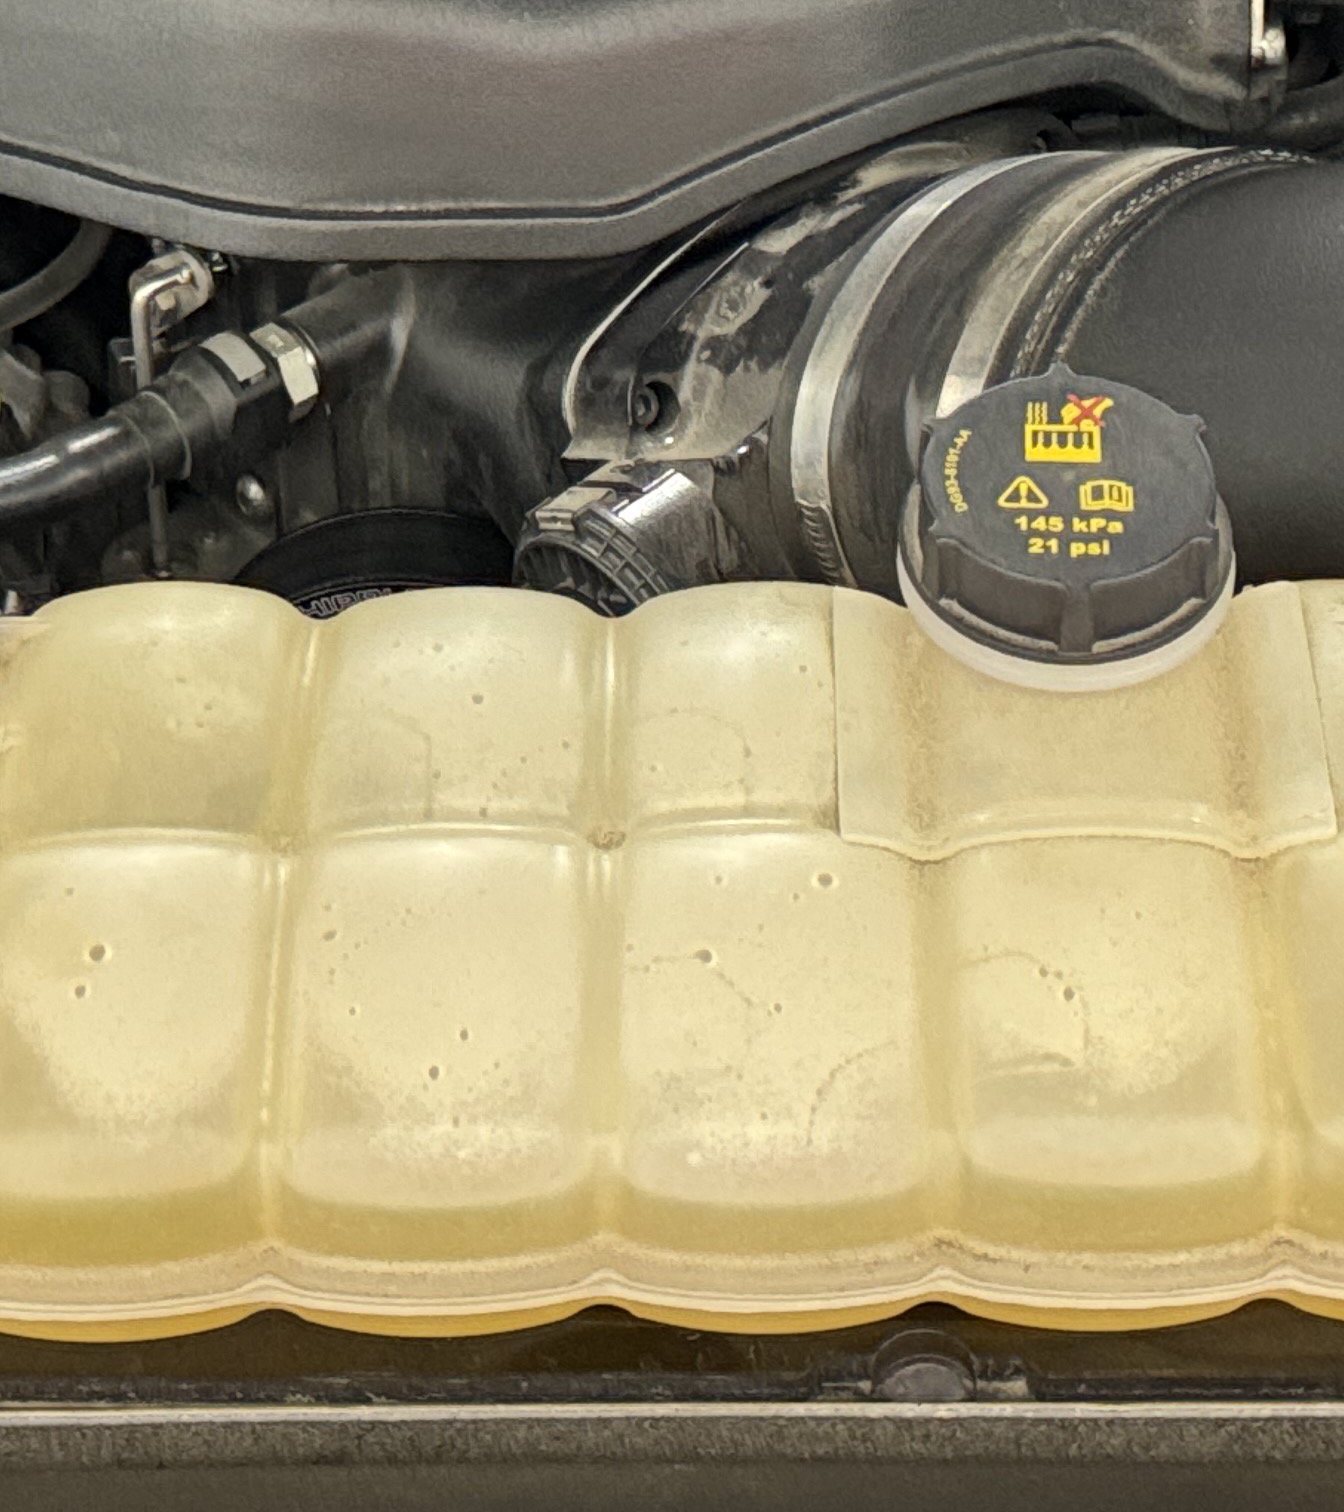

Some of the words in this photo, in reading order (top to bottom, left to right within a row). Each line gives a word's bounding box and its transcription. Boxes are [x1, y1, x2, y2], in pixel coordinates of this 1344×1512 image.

[1014, 516, 1064, 533] 145
[1072, 516, 1125, 534] kPa
[1028, 538, 1059, 555] 21
[1070, 538, 1111, 557] psi
